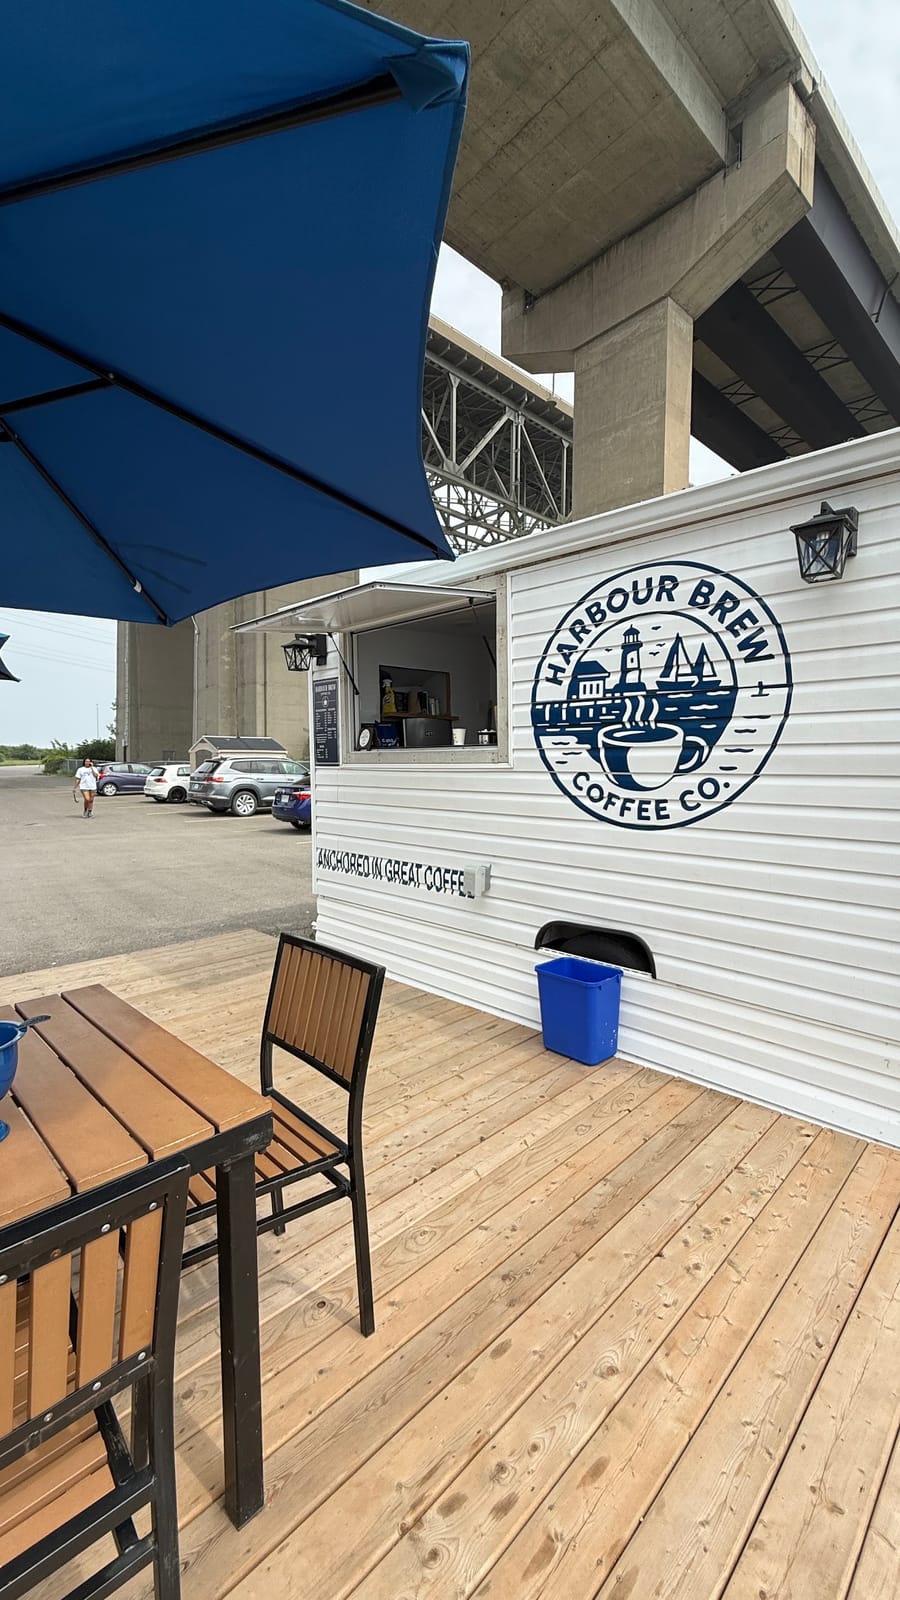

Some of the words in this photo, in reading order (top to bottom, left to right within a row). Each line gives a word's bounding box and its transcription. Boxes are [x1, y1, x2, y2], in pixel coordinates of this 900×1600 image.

[545, 575, 679, 686] HARBOUR
[688, 579, 775, 663] BREW
[573, 772, 670, 820] COFFEE
[680, 777, 730, 811] CO.
[317, 847, 370, 877] ANCHORED
[372, 856, 383, 880] IN
[384, 858, 422, 888] GREAT
[424, 865, 475, 898] COFFE
